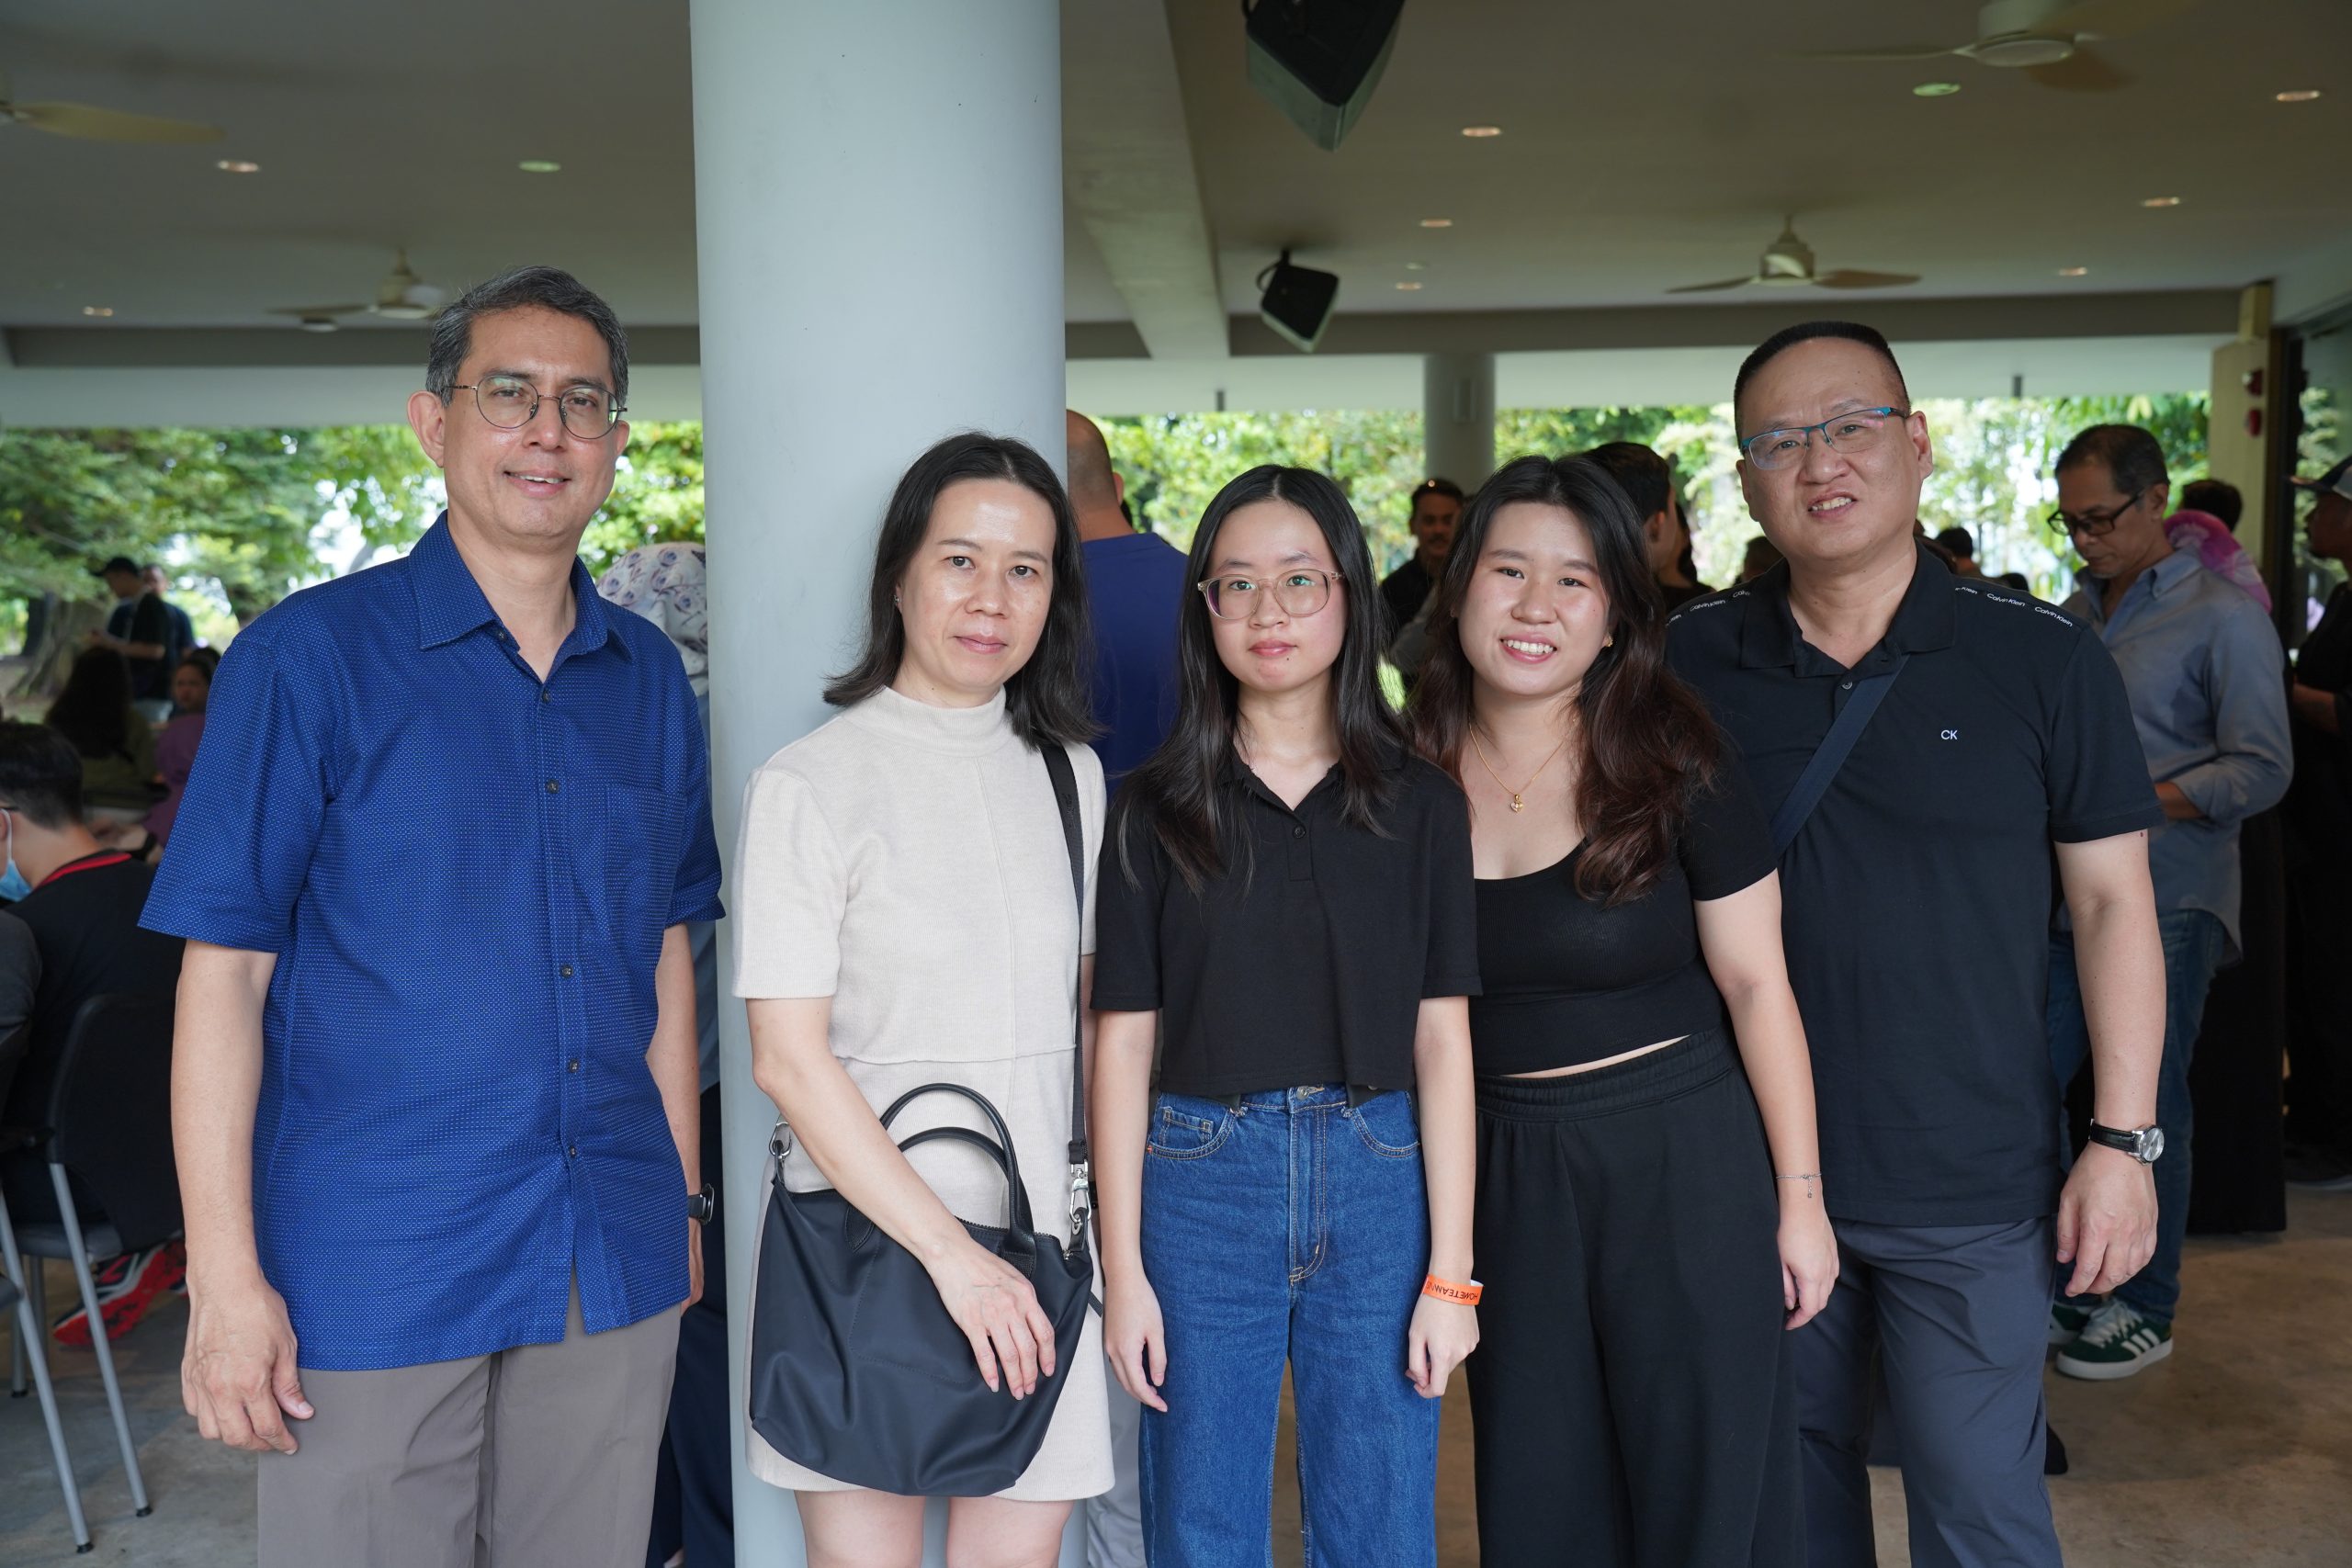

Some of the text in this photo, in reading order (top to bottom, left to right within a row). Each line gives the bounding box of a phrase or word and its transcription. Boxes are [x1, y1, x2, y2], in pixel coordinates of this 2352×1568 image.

[1690, 599, 1725, 613] Calvin Klein
[1986, 593, 2026, 607] Calvin Klein
[2034, 606, 2073, 627] Calvin Klein
[1940, 729, 1958, 740] CK
